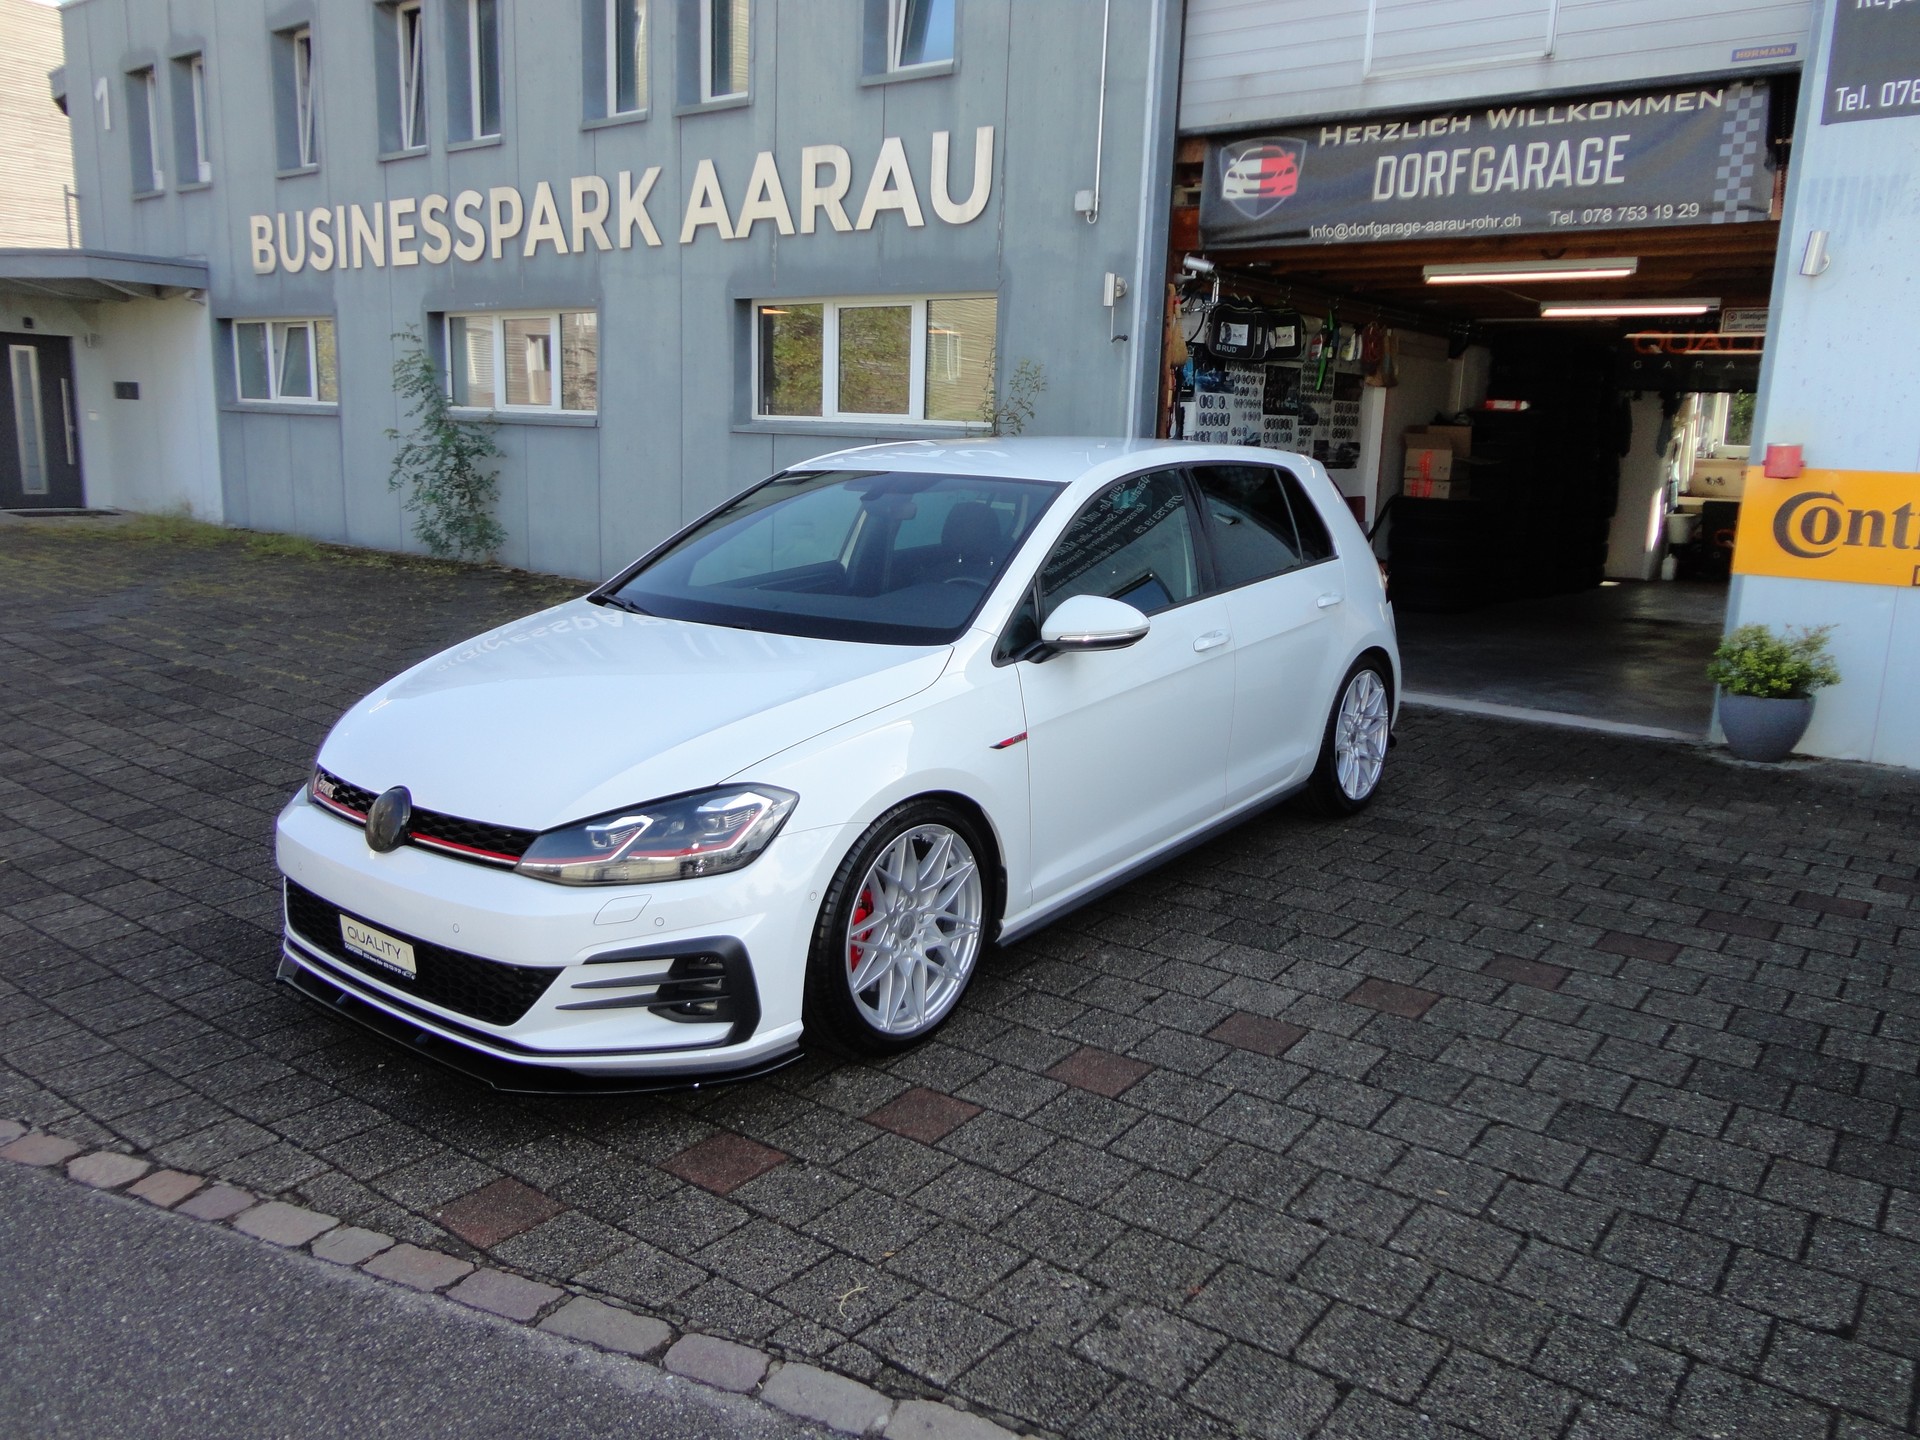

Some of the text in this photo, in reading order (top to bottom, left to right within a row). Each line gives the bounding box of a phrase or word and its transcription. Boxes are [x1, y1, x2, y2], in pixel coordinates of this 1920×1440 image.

[94, 77, 111, 129] 1
[1319, 89, 1723, 148] HERZLICH WILLKOMMEN
[1836, 84, 1871, 112] Tel.
[1372, 134, 1631, 202] DORFGARAGE
[250, 126, 994, 275] BUSINESSPARK AARAU
[1310, 202, 1700, 239] Info@dorfgarage-aarau-rohr.ch Tel. 078 753 19 29
[1773, 490, 1920, 558] Cont
